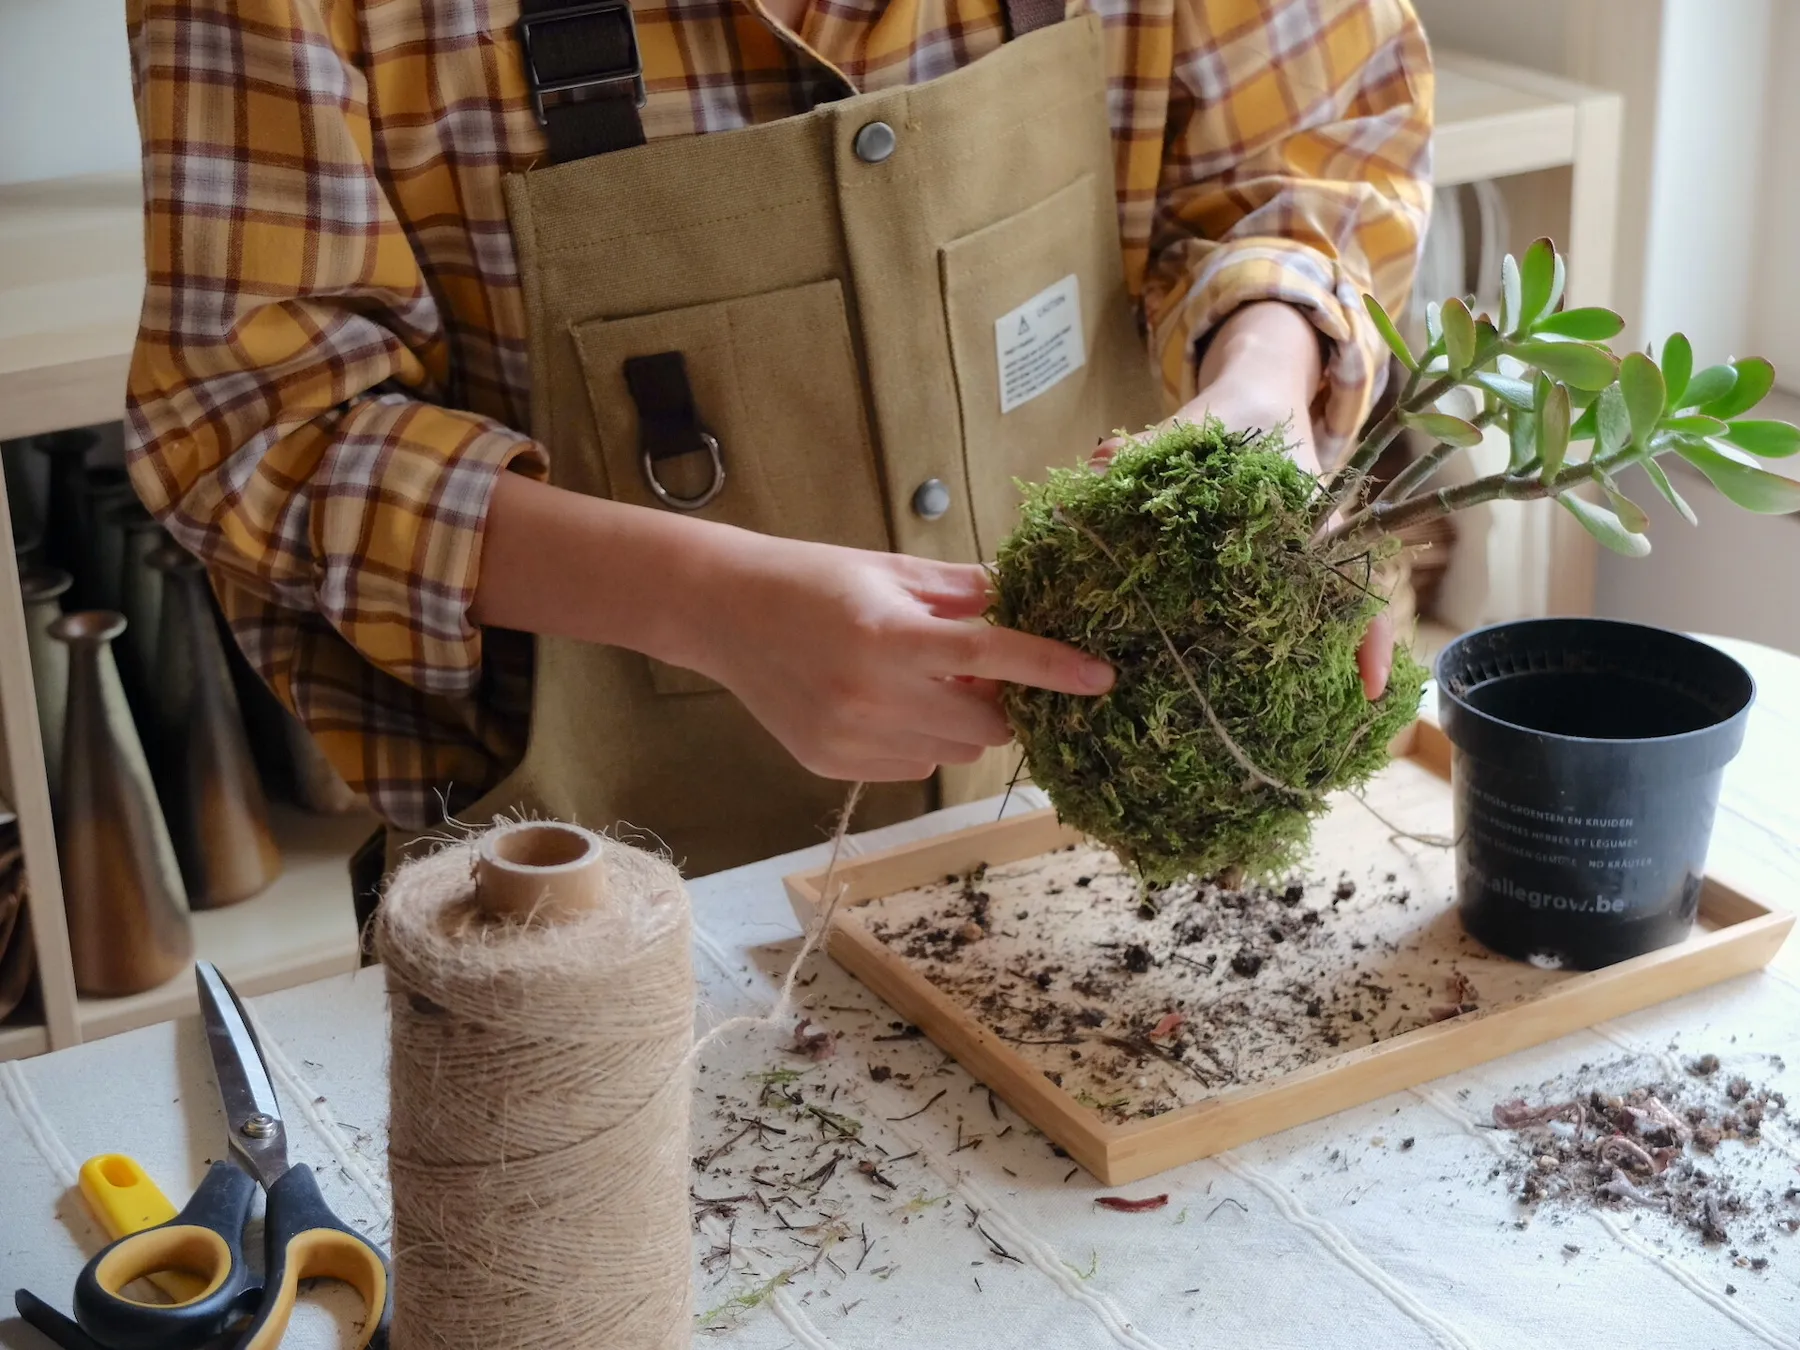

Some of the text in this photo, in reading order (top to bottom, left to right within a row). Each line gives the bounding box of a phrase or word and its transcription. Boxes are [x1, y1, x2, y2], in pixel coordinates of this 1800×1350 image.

[1510, 803, 1565, 824] GROENTEN
[1567, 814, 1582, 826] EN
[1585, 817, 1634, 828] KRUIDEN
[1574, 837, 1587, 848] ET
